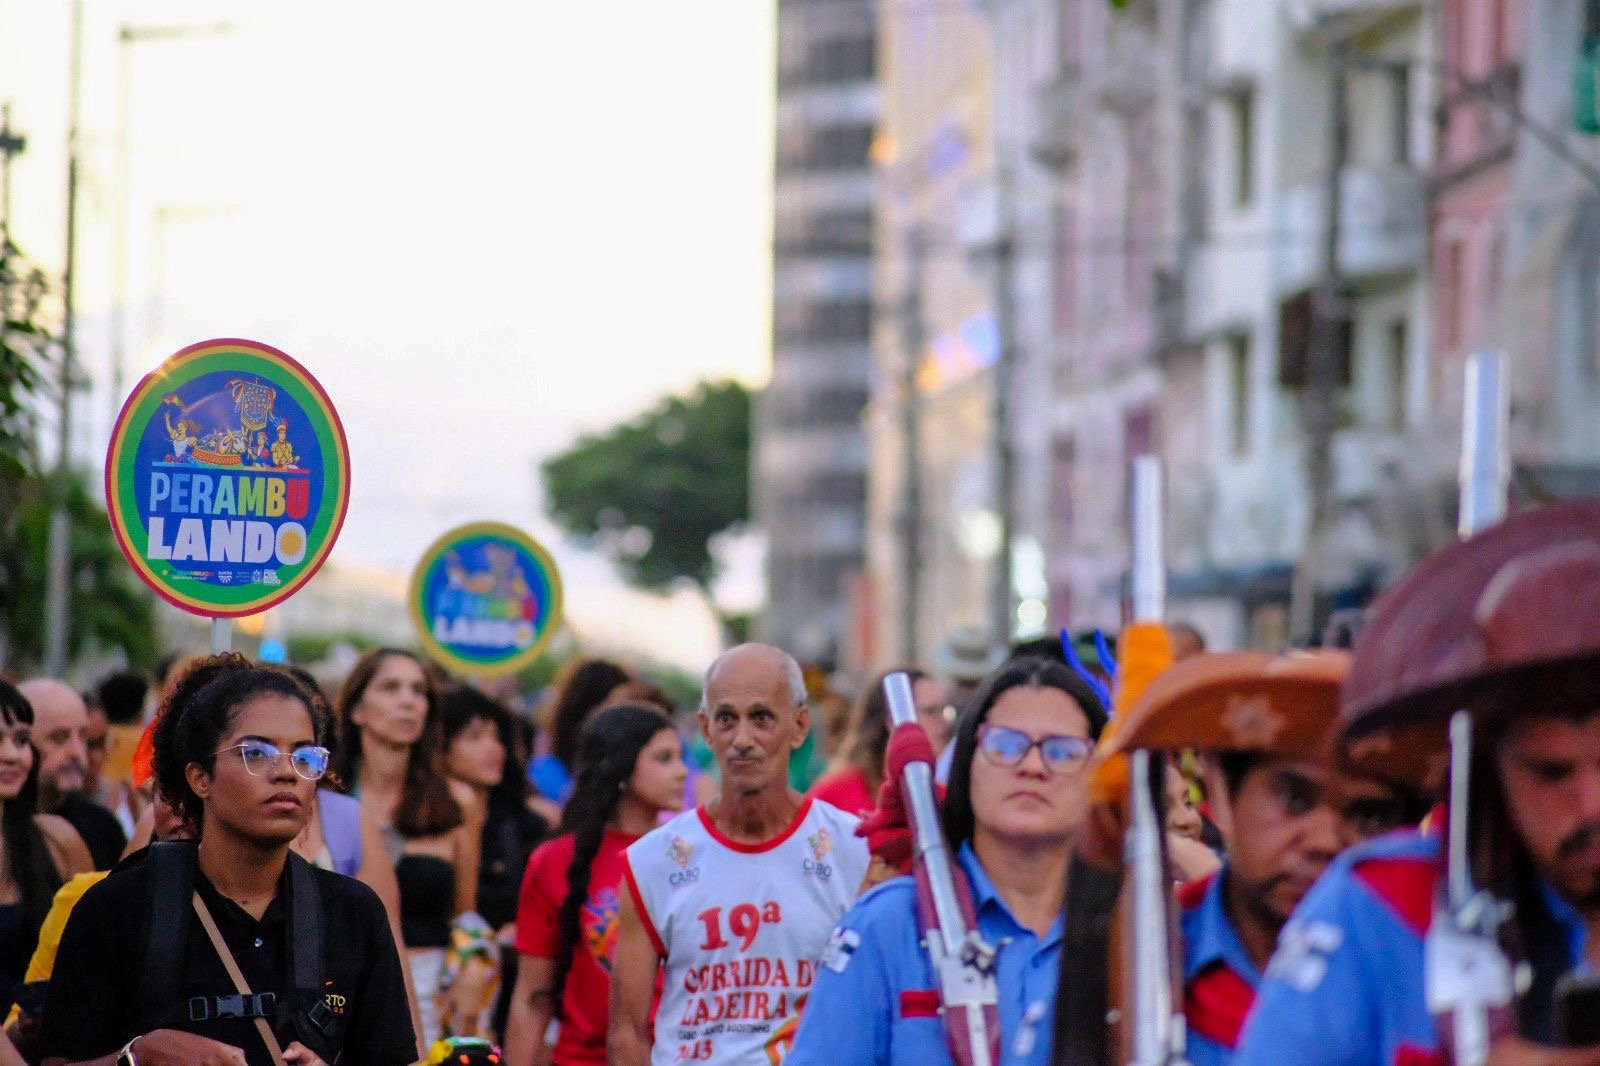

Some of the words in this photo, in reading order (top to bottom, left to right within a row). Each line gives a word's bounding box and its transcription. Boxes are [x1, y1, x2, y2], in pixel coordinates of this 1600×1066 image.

[150, 471, 310, 519] PERAMBU
[147, 516, 307, 565] LANDO
[802, 858, 832, 878] CBO
[683, 957, 790, 994] CORRIDA
